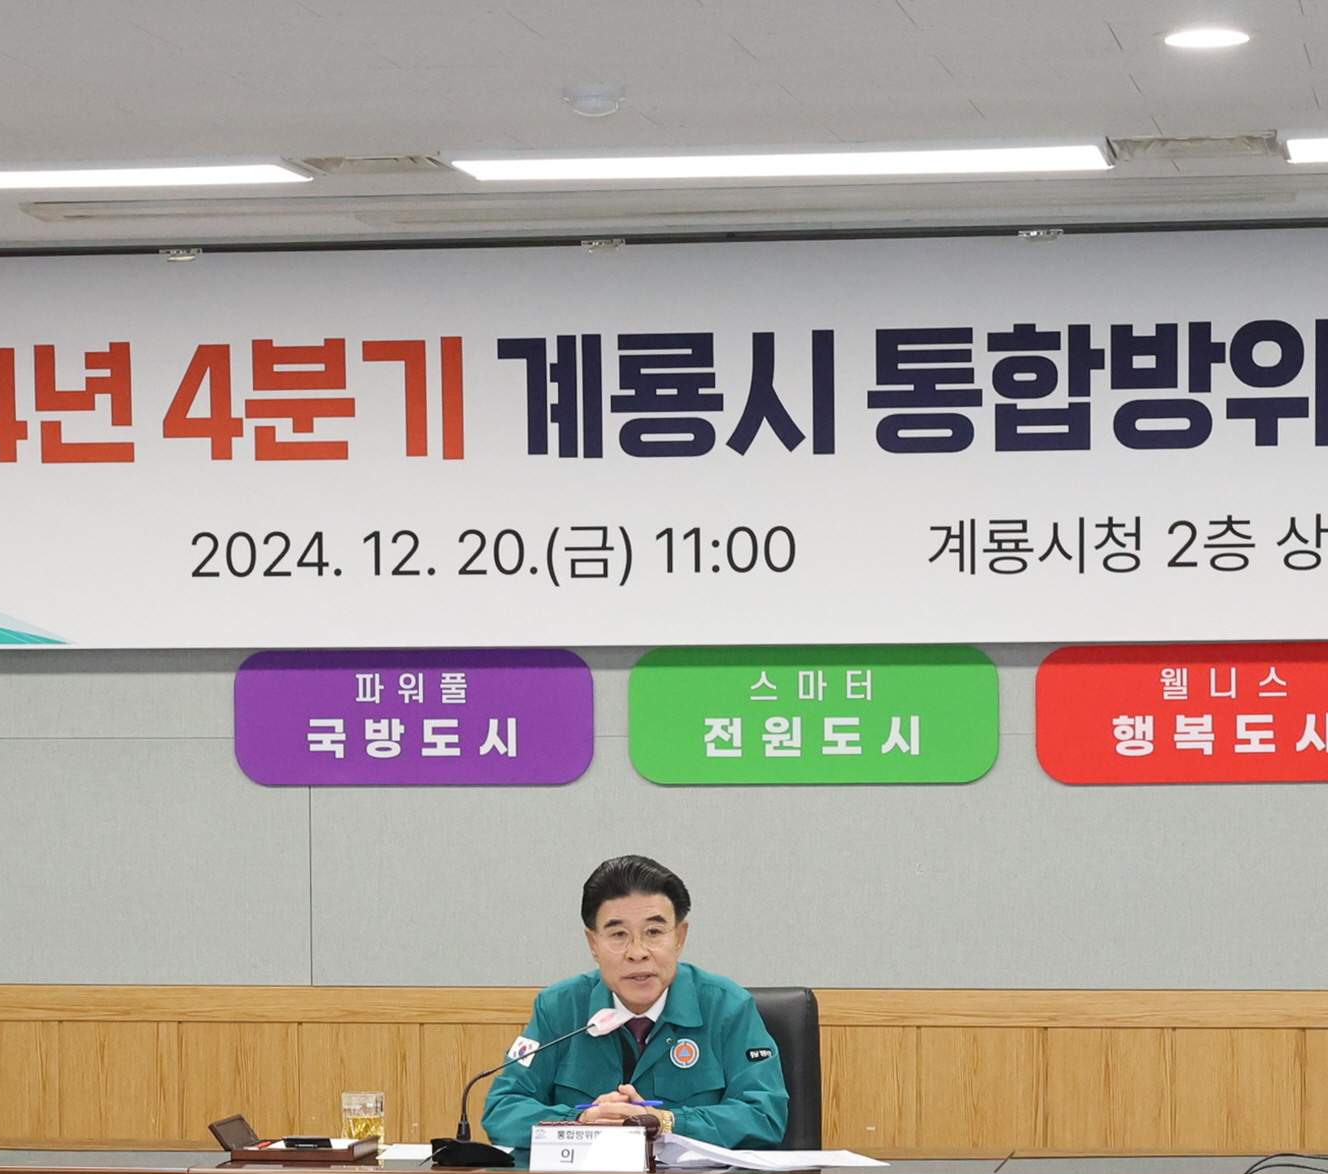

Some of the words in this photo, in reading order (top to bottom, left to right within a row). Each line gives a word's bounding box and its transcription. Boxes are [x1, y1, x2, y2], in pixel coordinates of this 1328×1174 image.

[163, 335, 465, 461] 4분기
[497, 329, 836, 459] 계룡시
[191, 531, 343, 578] 2024.
[363, 529, 437, 576] 12.
[458, 526, 633, 587] 20.(금)
[655, 525, 797, 574] 11:00
[928, 516, 1142, 576] 계룡시청
[1167, 514, 1256, 572] 2층
[354, 672, 468, 705] 파워풀
[749, 669, 874, 703] 스마터
[1159, 667, 1289, 701] 웰니스
[306, 717, 518, 759] 국방도시
[703, 715, 921, 758] 전원도시
